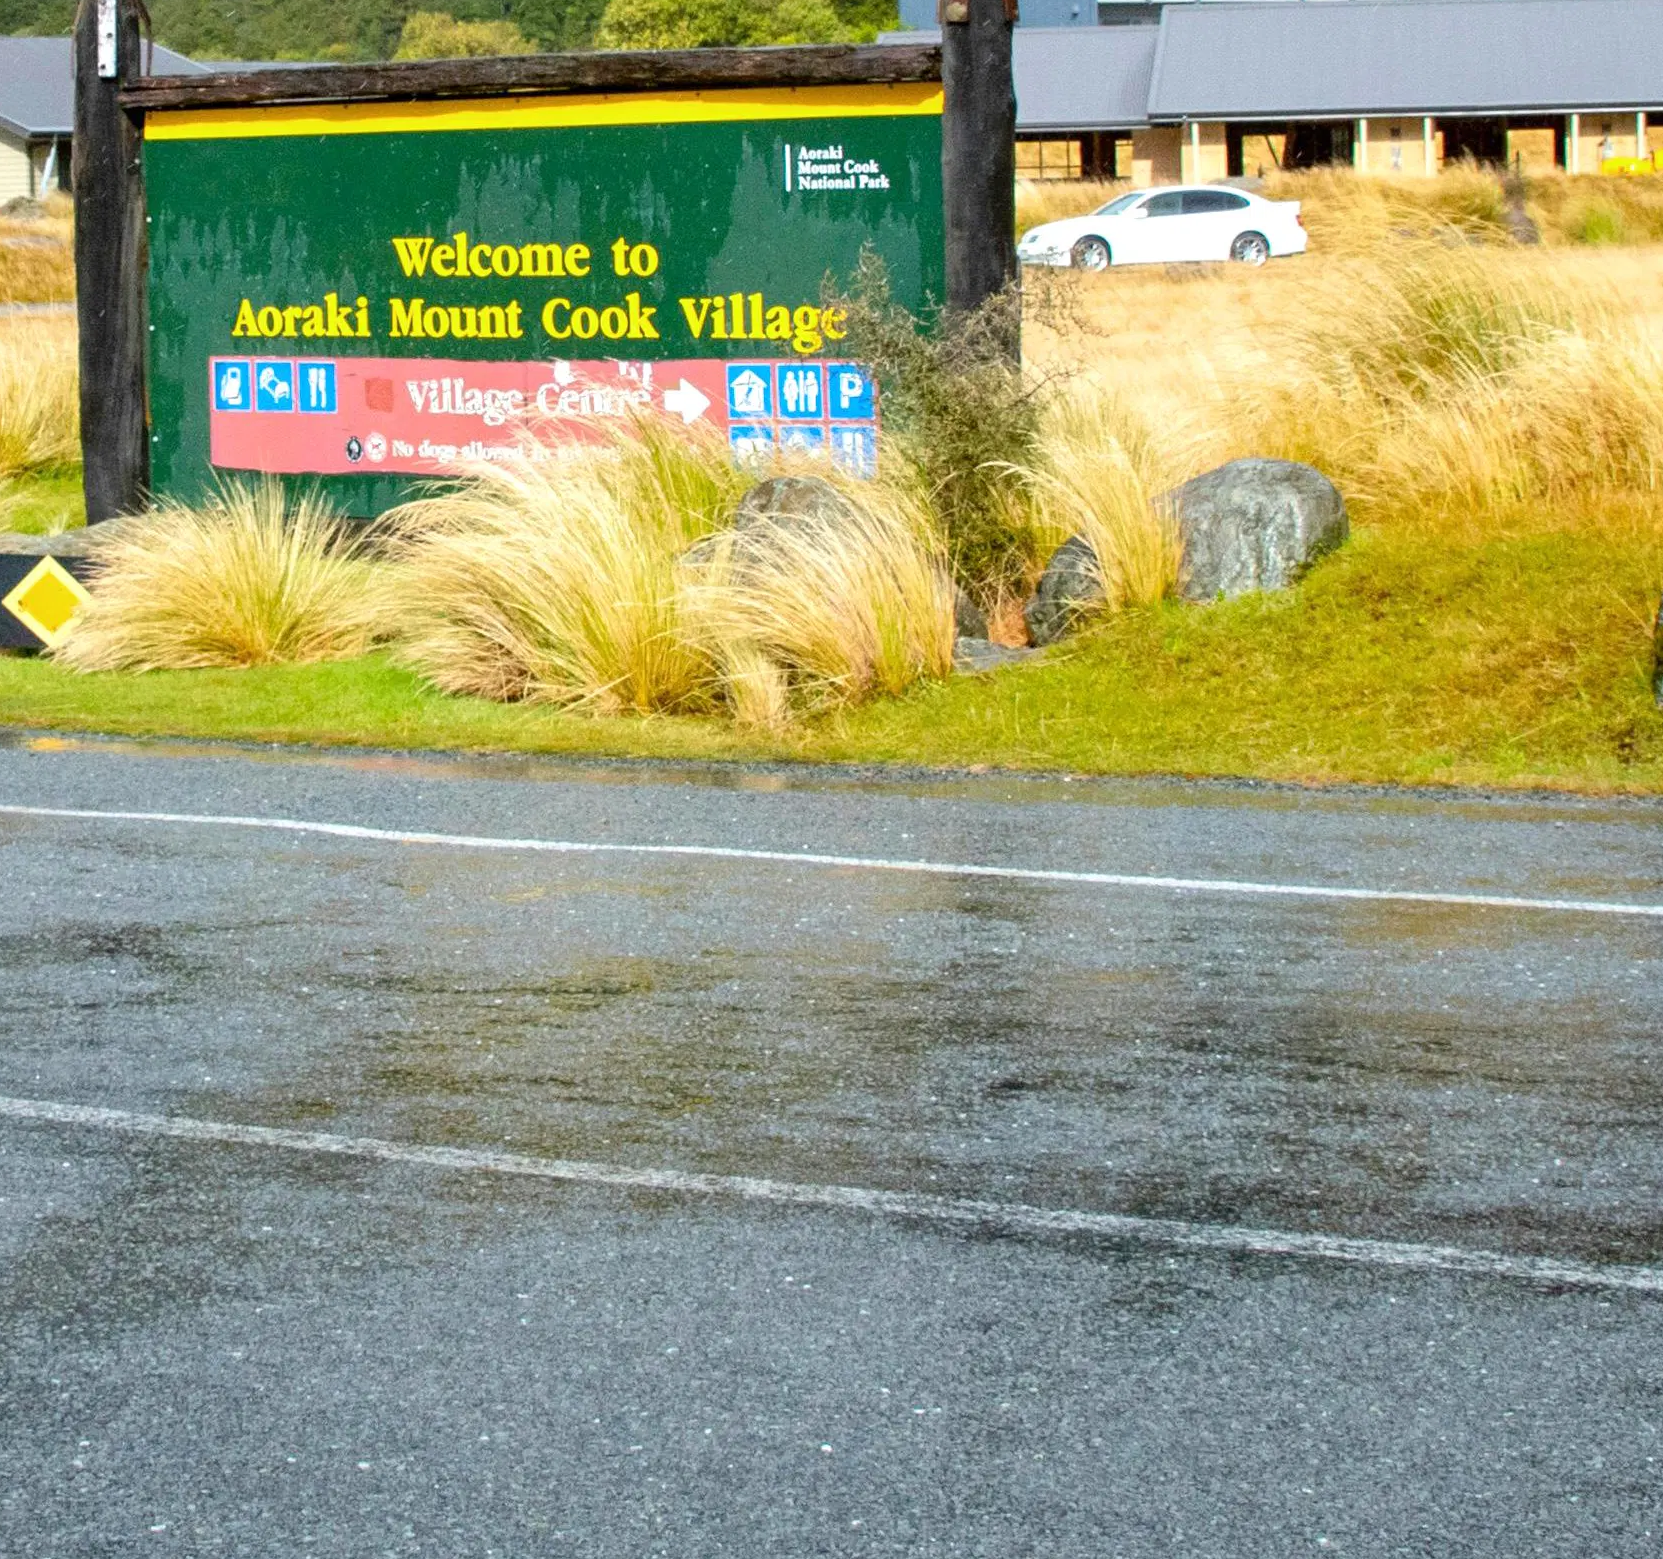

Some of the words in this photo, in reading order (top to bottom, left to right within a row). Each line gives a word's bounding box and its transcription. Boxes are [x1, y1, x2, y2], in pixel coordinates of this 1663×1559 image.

[797, 145, 843, 160] Aoraki
[797, 161, 841, 175] Mount
[843, 159, 879, 174] Cook
[797, 176, 855, 190] National
[859, 174, 890, 189] Park
[391, 230, 591, 278] Welcome
[610, 237, 659, 278] to
[231, 292, 372, 339] Aoraki
[388, 297, 524, 340] Mount
[541, 292, 660, 340] Cook
[678, 292, 848, 355] Village
[405, 376, 524, 427] Village
[536, 382, 652, 418] Centre
[839, 372, 864, 410] P
[391, 438, 414, 458] No
[418, 438, 458, 463] dogs
